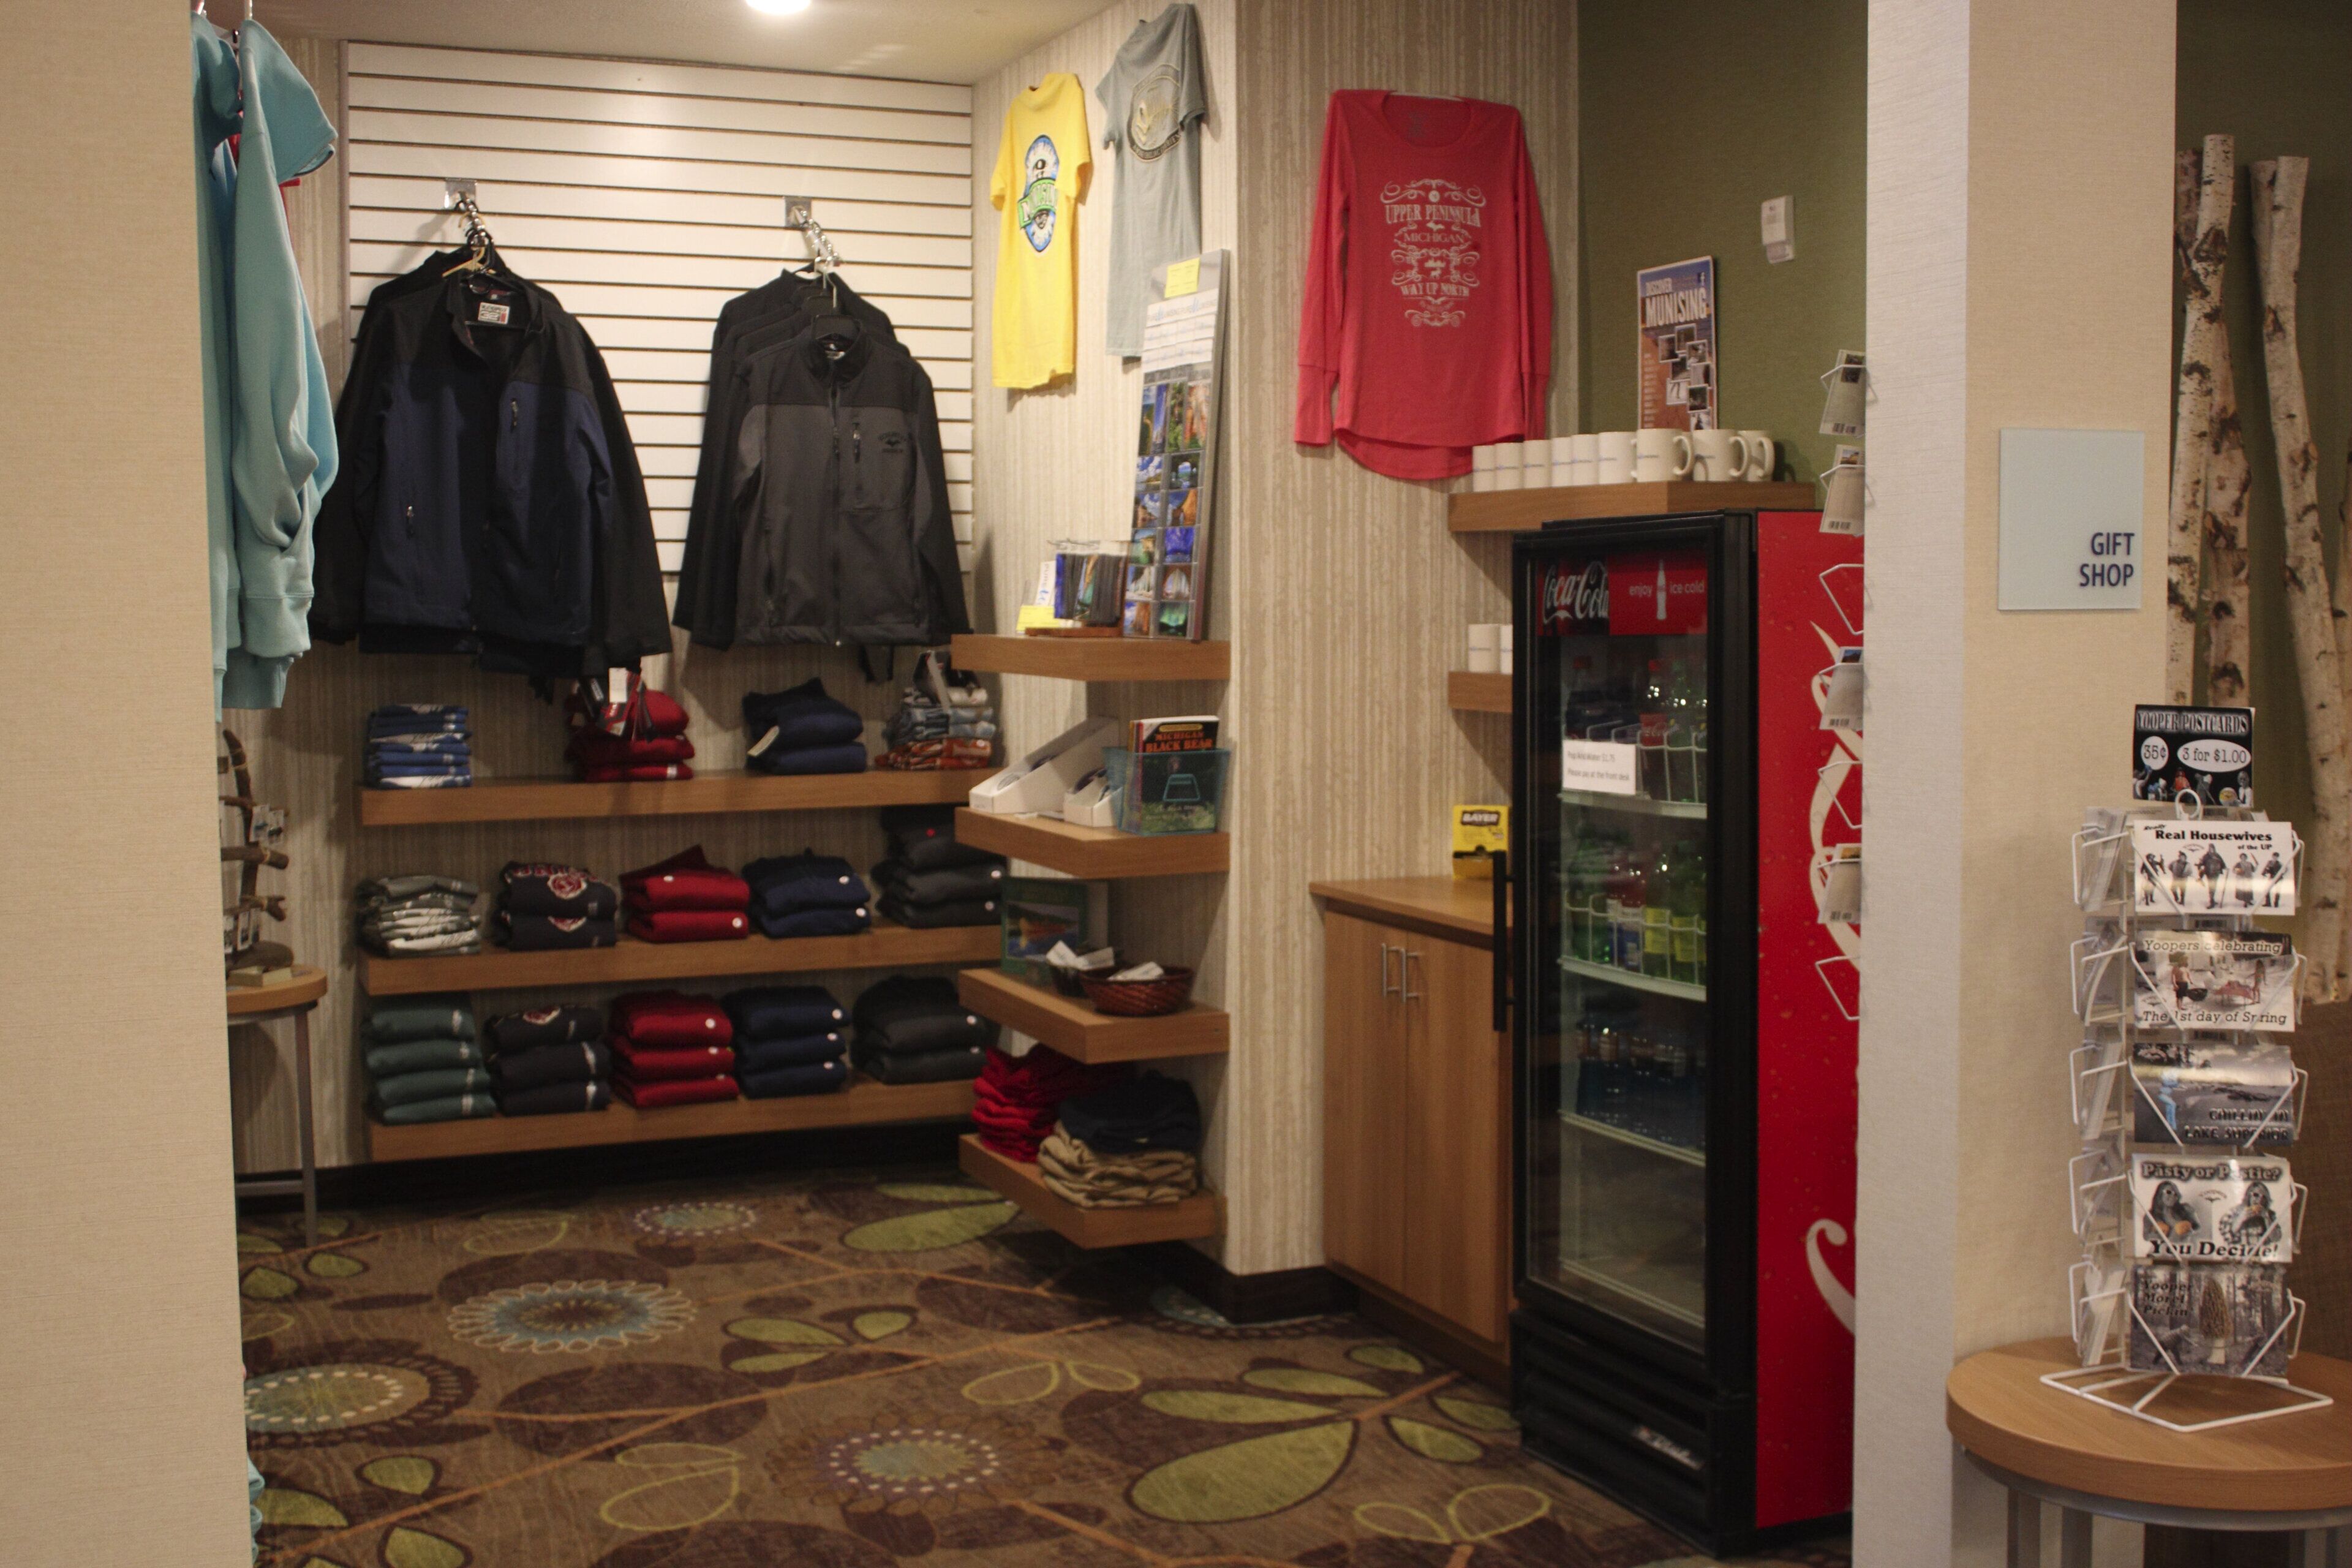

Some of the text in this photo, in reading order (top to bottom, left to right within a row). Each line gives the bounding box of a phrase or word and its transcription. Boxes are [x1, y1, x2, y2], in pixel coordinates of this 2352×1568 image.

[1385, 204, 1481, 227] UPPER PENINSULA
[1404, 233, 1464, 243] MICHIGAN
[1400, 282, 1469, 296] WAY UP NORTH
[1645, 287, 1707, 327] MUNISING
[2091, 532, 2135, 556] GIFT
[2079, 564, 2134, 587] SHOP
[1629, 581, 1705, 598] enjoy ice cold
[2136, 711, 2248, 734] YOOPER POSTCARDS
[1146, 738, 1213, 753] BLACK BEAR
[2144, 744, 2166, 761] 35¢
[2182, 747, 2247, 763] 3 for $1.00
[1463, 813, 1498, 822] BAYER
[2155, 830, 2272, 841] Real Housewives
[2145, 940, 2199, 952] Yoopers
[2143, 1011, 2168, 1021] The
[2196, 1011, 2221, 1023] day
[2225, 1012, 2239, 1022] of
[2184, 1125, 2218, 1138] LAKE
[2144, 1163, 2282, 1181] Pasty or Pstie?
